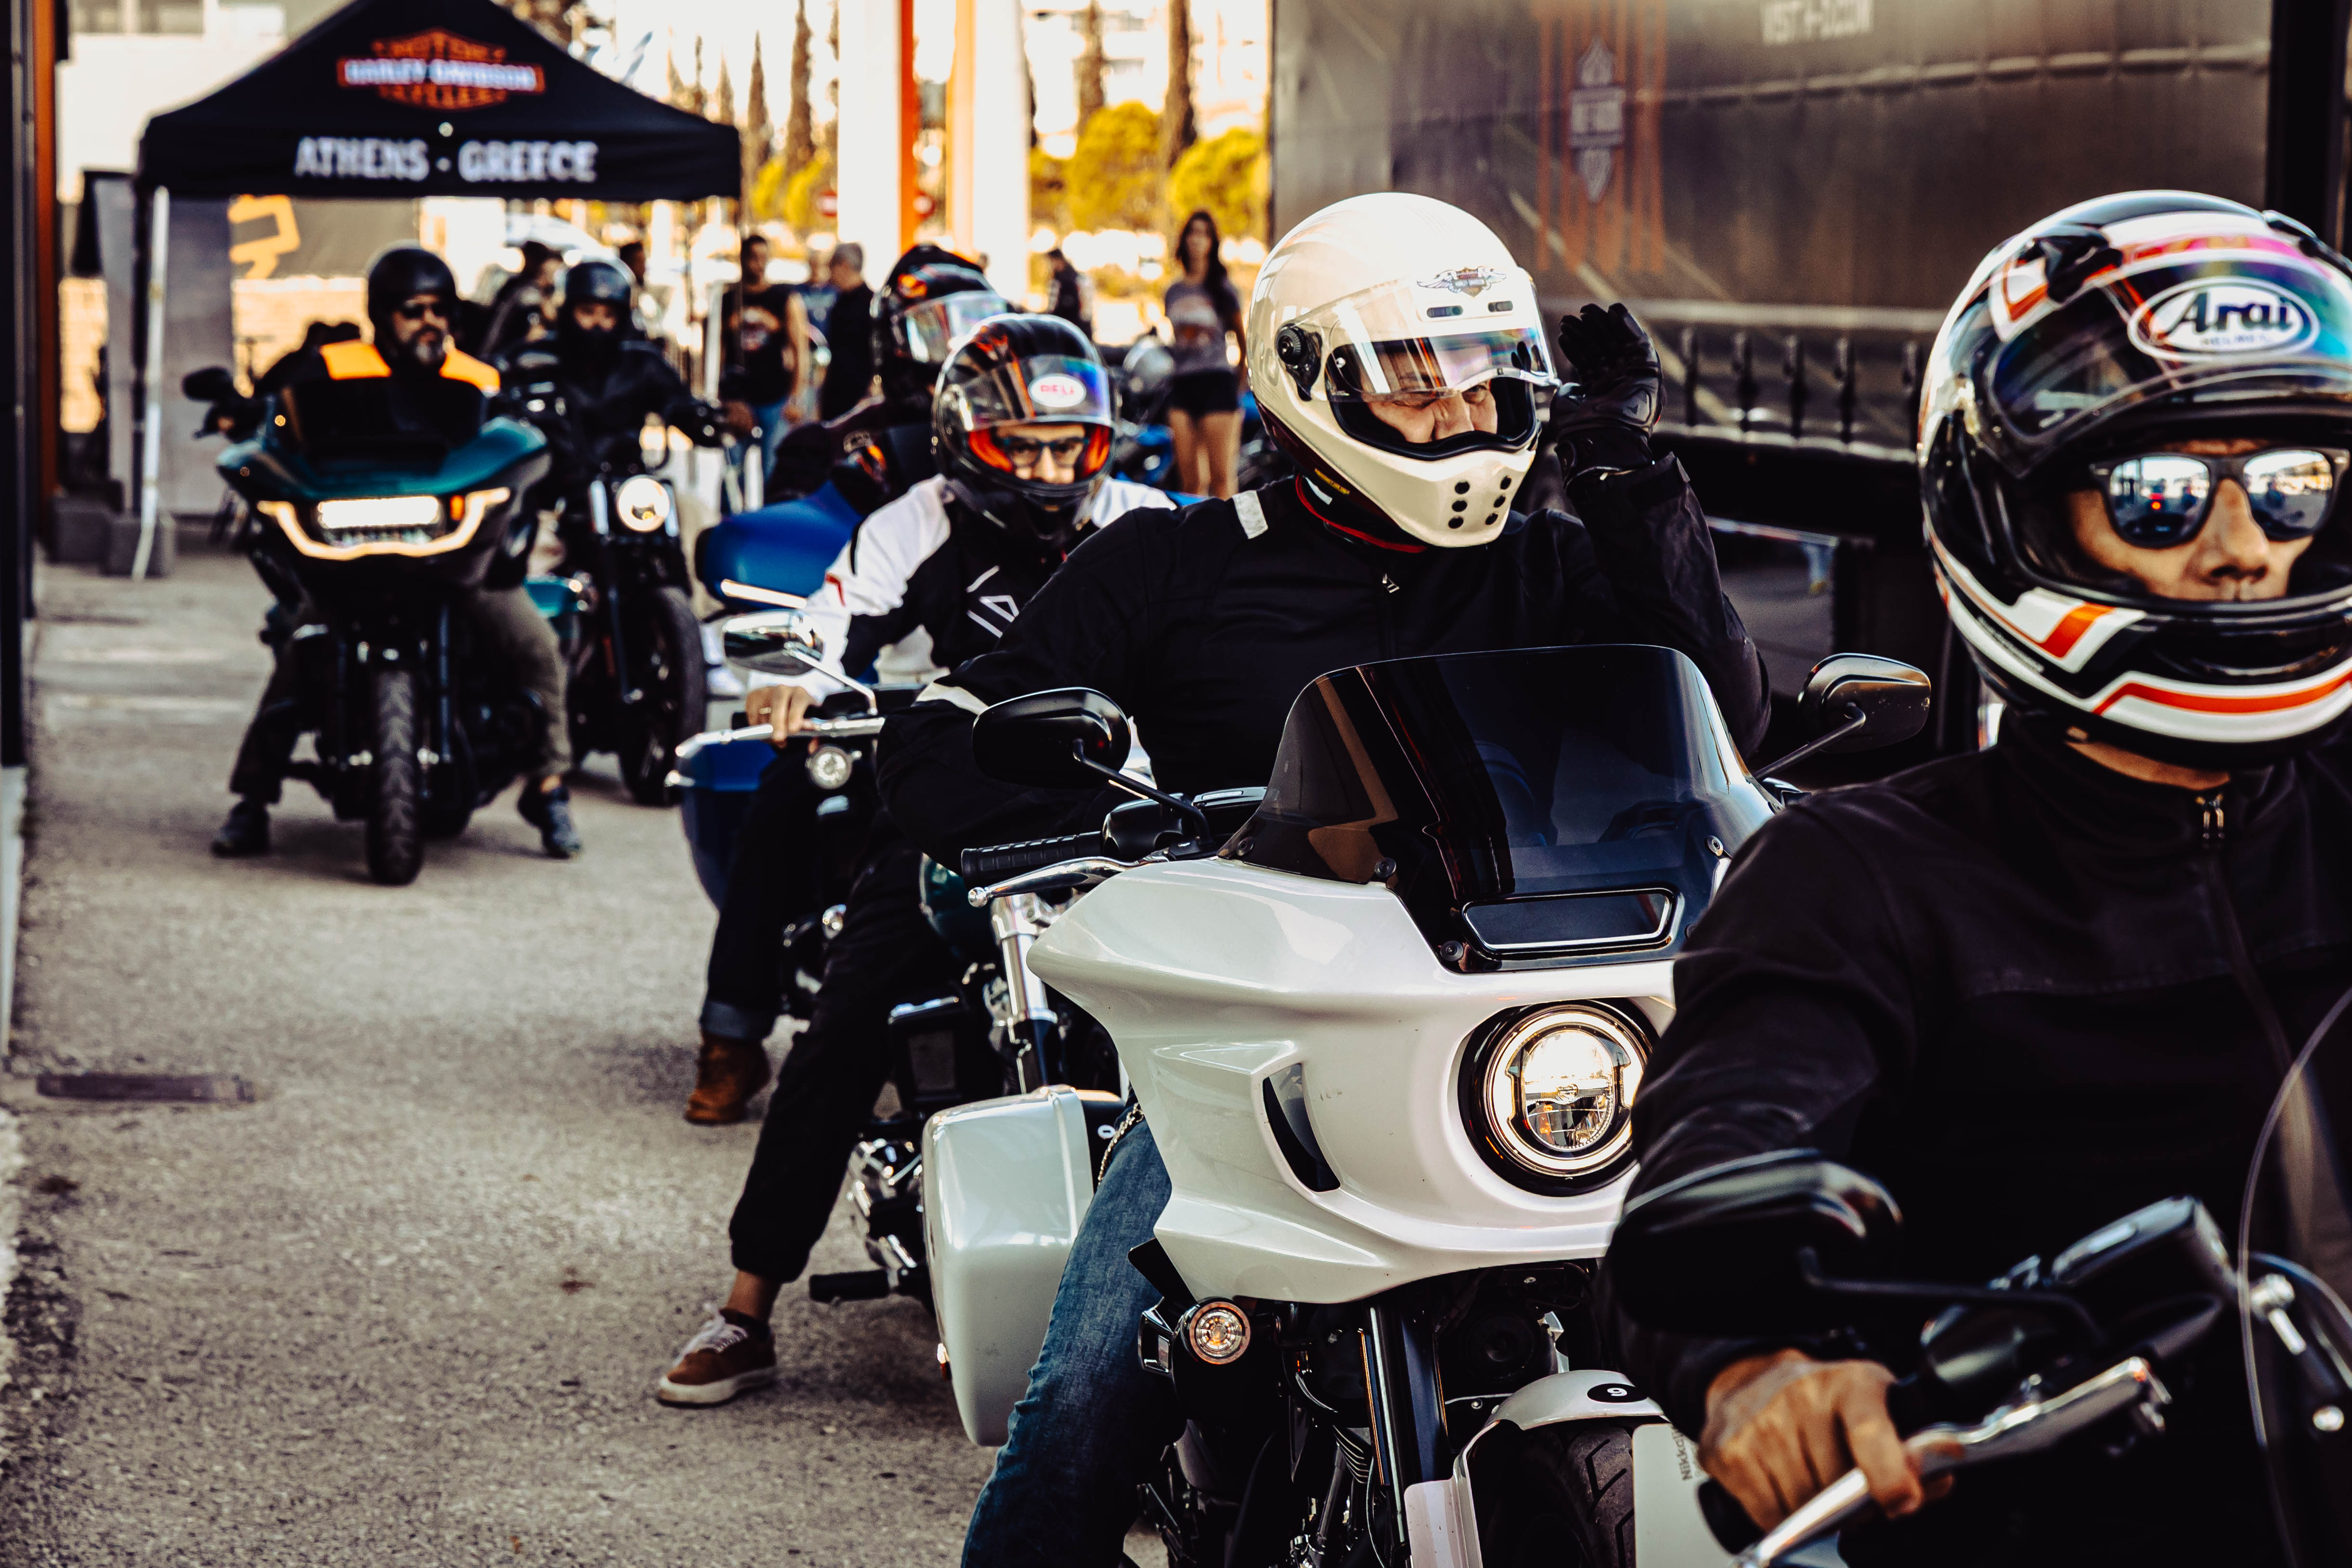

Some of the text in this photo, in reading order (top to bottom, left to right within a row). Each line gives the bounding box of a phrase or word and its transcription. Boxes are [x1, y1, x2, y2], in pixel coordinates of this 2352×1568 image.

[294, 136, 599, 182] ATHENS GREECE
[2159, 290, 2293, 336] Arai
[1607, 1387, 1628, 1397] 9
